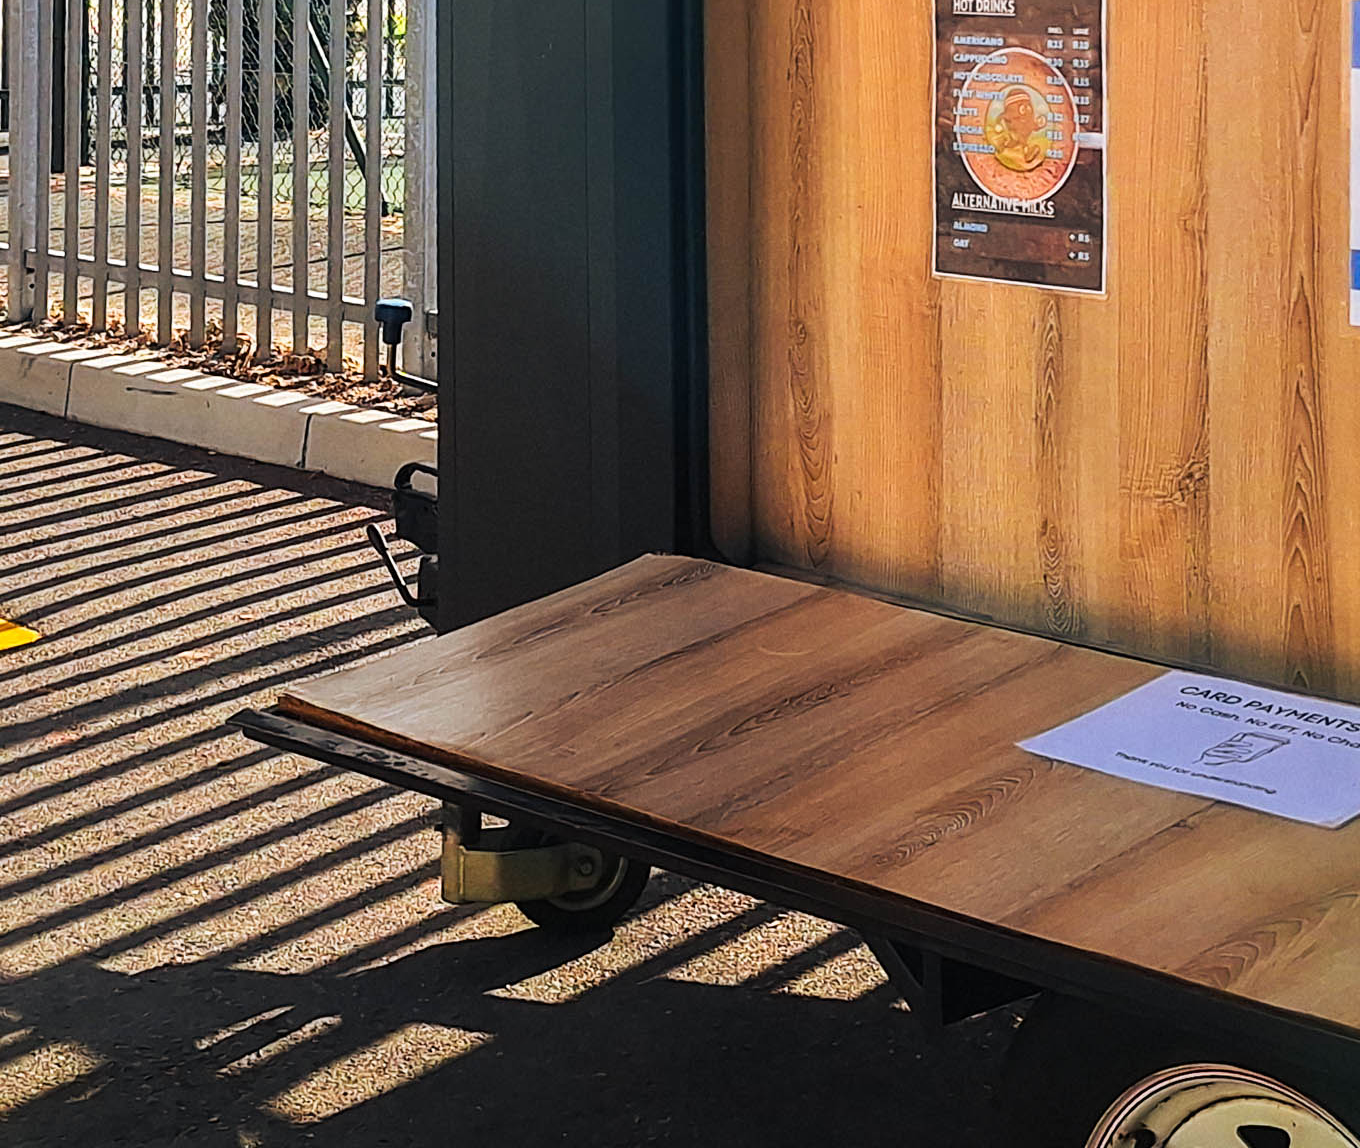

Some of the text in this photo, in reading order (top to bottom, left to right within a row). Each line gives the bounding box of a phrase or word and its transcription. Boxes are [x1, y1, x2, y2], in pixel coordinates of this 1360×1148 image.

[952, 192, 1055, 215] ALTERNATIVE MILKS
[1180, 686, 1242, 705] CARD
[1175, 700, 1198, 710] No
[1244, 717, 1267, 727] No
[1302, 730, 1325, 740] No
